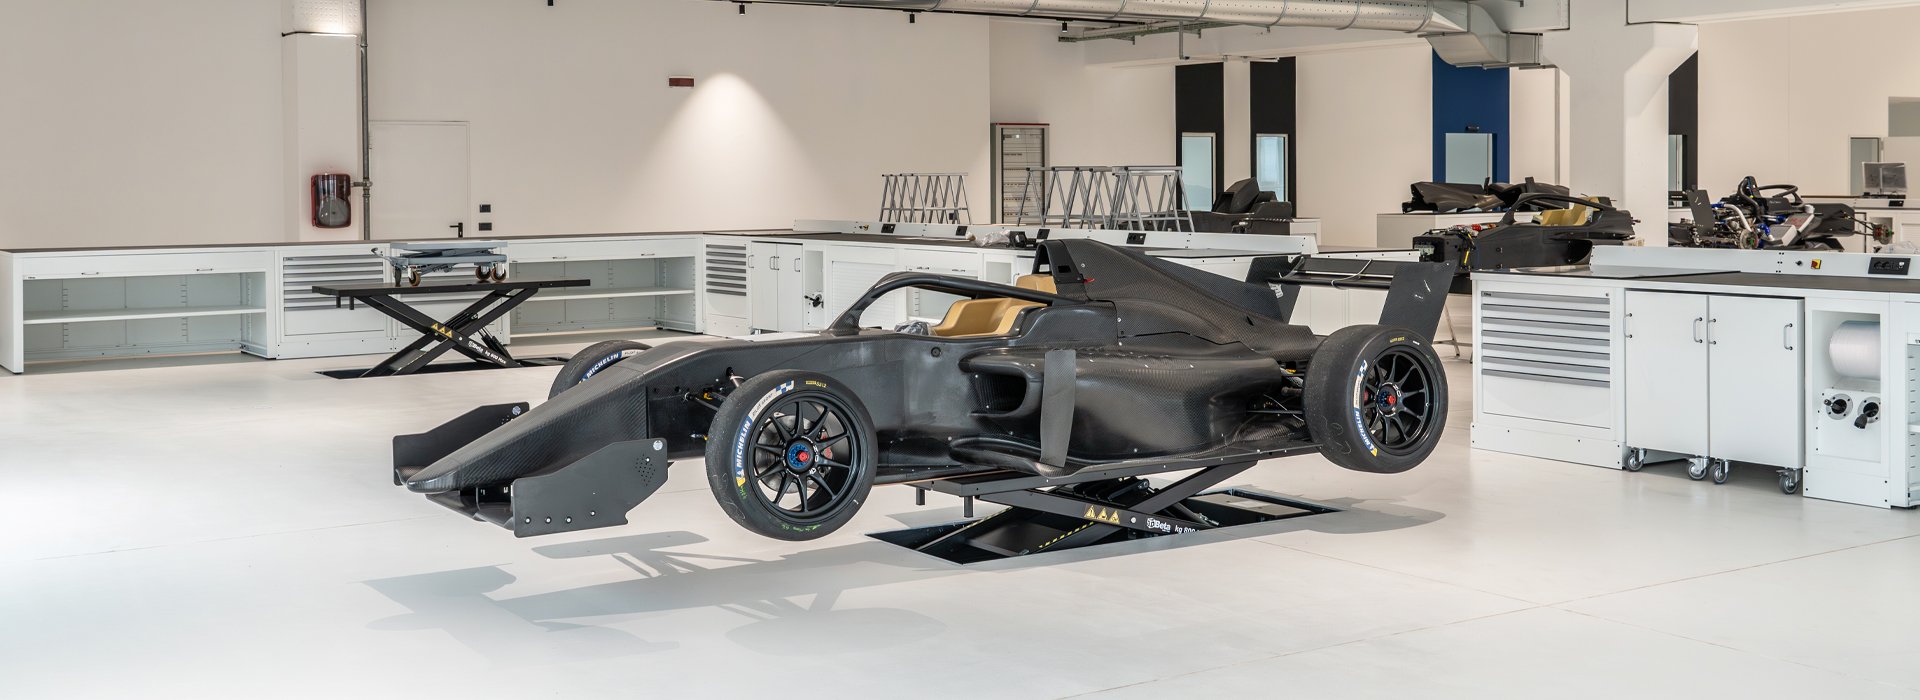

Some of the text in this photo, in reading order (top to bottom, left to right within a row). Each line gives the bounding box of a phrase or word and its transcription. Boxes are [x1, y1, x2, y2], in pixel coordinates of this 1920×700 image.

[586, 353, 619, 378] MICHELIN
[1355, 411, 1371, 446] MICHELIN
[736, 420, 751, 469] MICHELIN
[1155, 520, 1171, 532] Beta
[1175, 525, 1183, 534] kg
